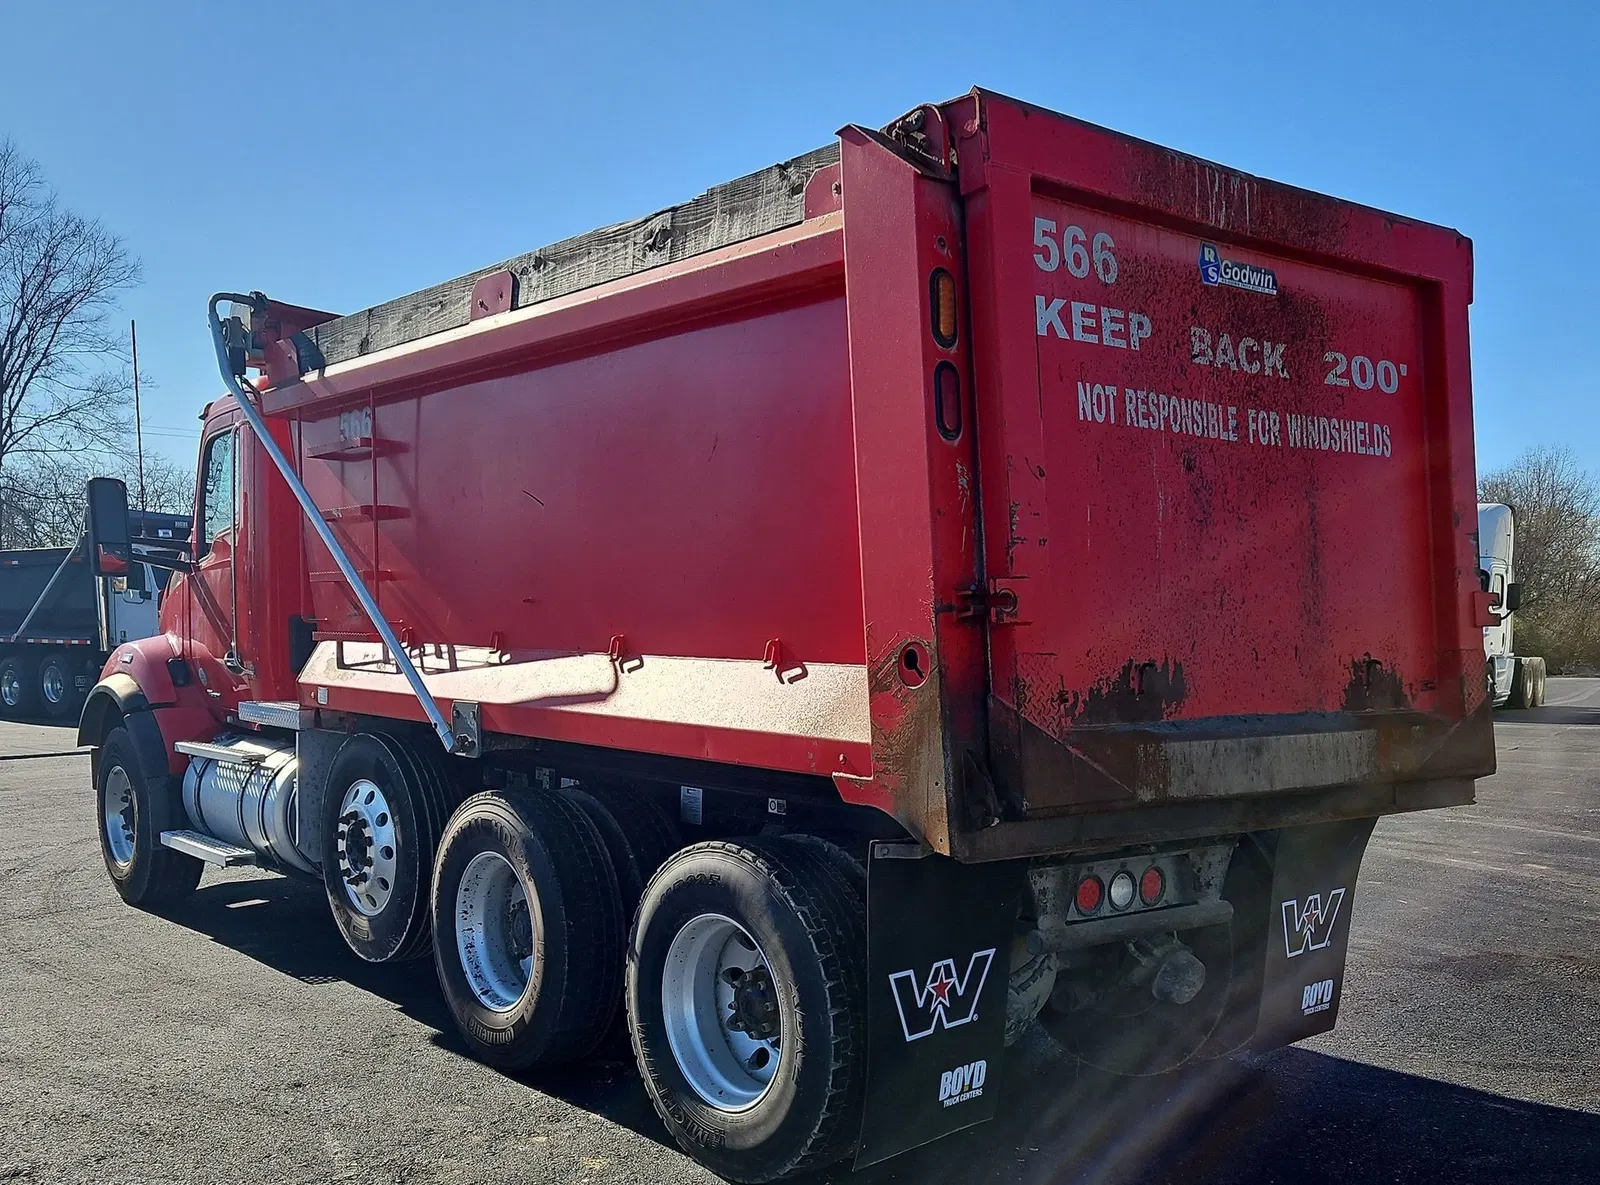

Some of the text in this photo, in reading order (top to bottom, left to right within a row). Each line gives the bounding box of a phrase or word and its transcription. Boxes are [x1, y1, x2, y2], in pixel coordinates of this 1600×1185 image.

[1033, 216, 1118, 284] 566
[1035, 295, 1152, 352] KEEP
[1190, 326, 1290, 379] BACK
[1077, 381, 1391, 458] NOT RESPONSIBLE FOR WINDSHIELDS
[1301, 979, 1334, 1010] BOYD
[939, 1060, 987, 1101] BOYD
[960, 1088, 983, 1102] CENTERS
